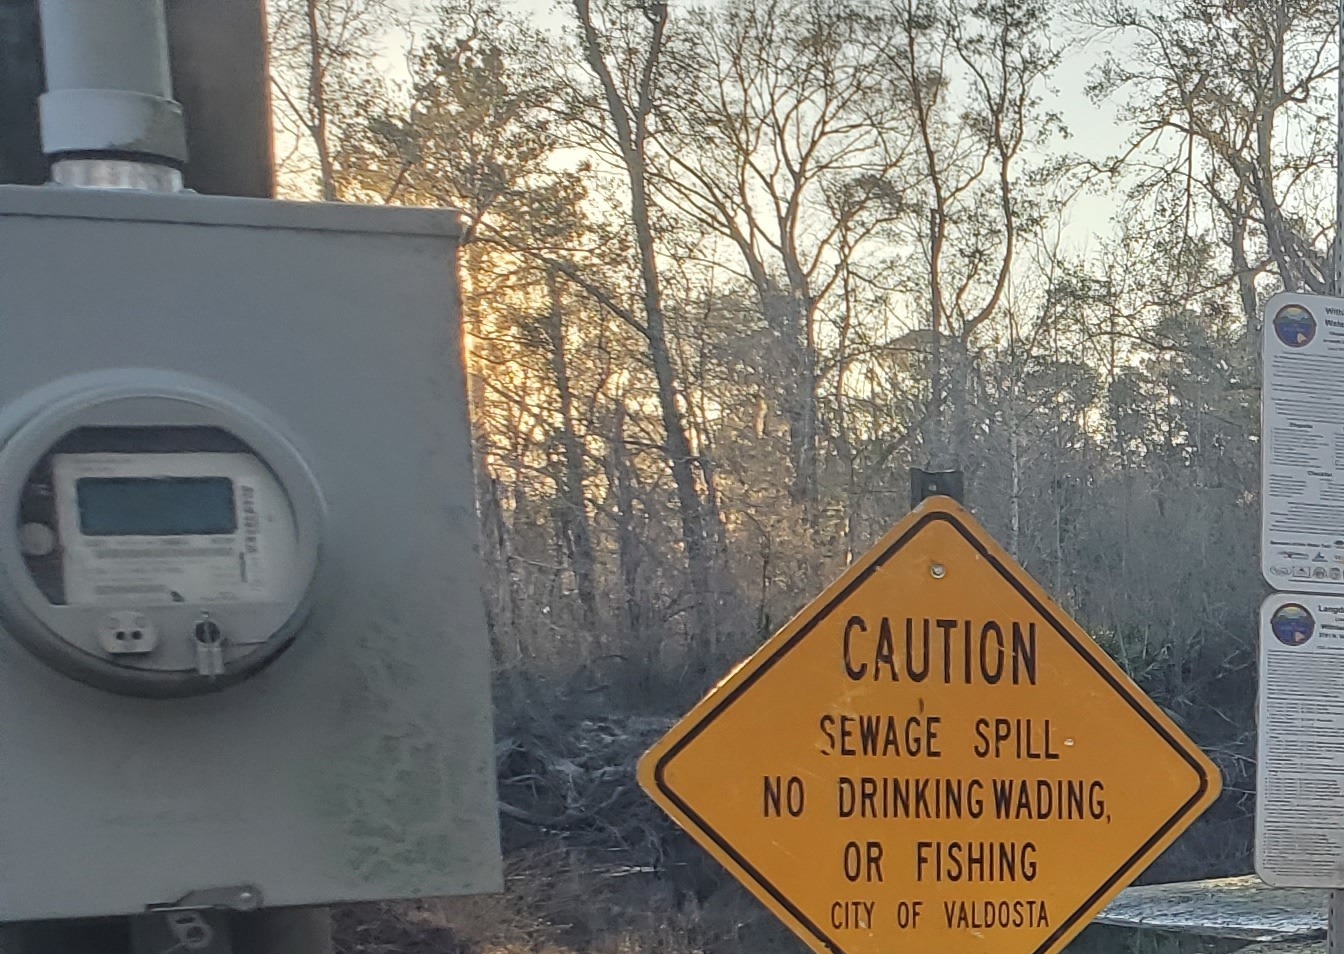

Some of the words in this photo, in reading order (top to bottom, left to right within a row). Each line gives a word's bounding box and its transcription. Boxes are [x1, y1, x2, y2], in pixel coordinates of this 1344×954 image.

[843, 615, 1037, 686] CAUTION
[819, 714, 942, 758] SEWAGE
[973, 718, 1060, 760] SPILL
[763, 775, 806, 818] NO
[838, 777, 984, 820] DRINKING
[992, 778, 1112, 825] WADING,
[843, 841, 884, 883] OR
[916, 841, 1038, 883] FISHING
[830, 901, 876, 930] CITY
[897, 901, 923, 930] OF
[944, 900, 1050, 930] VALDOSTA
